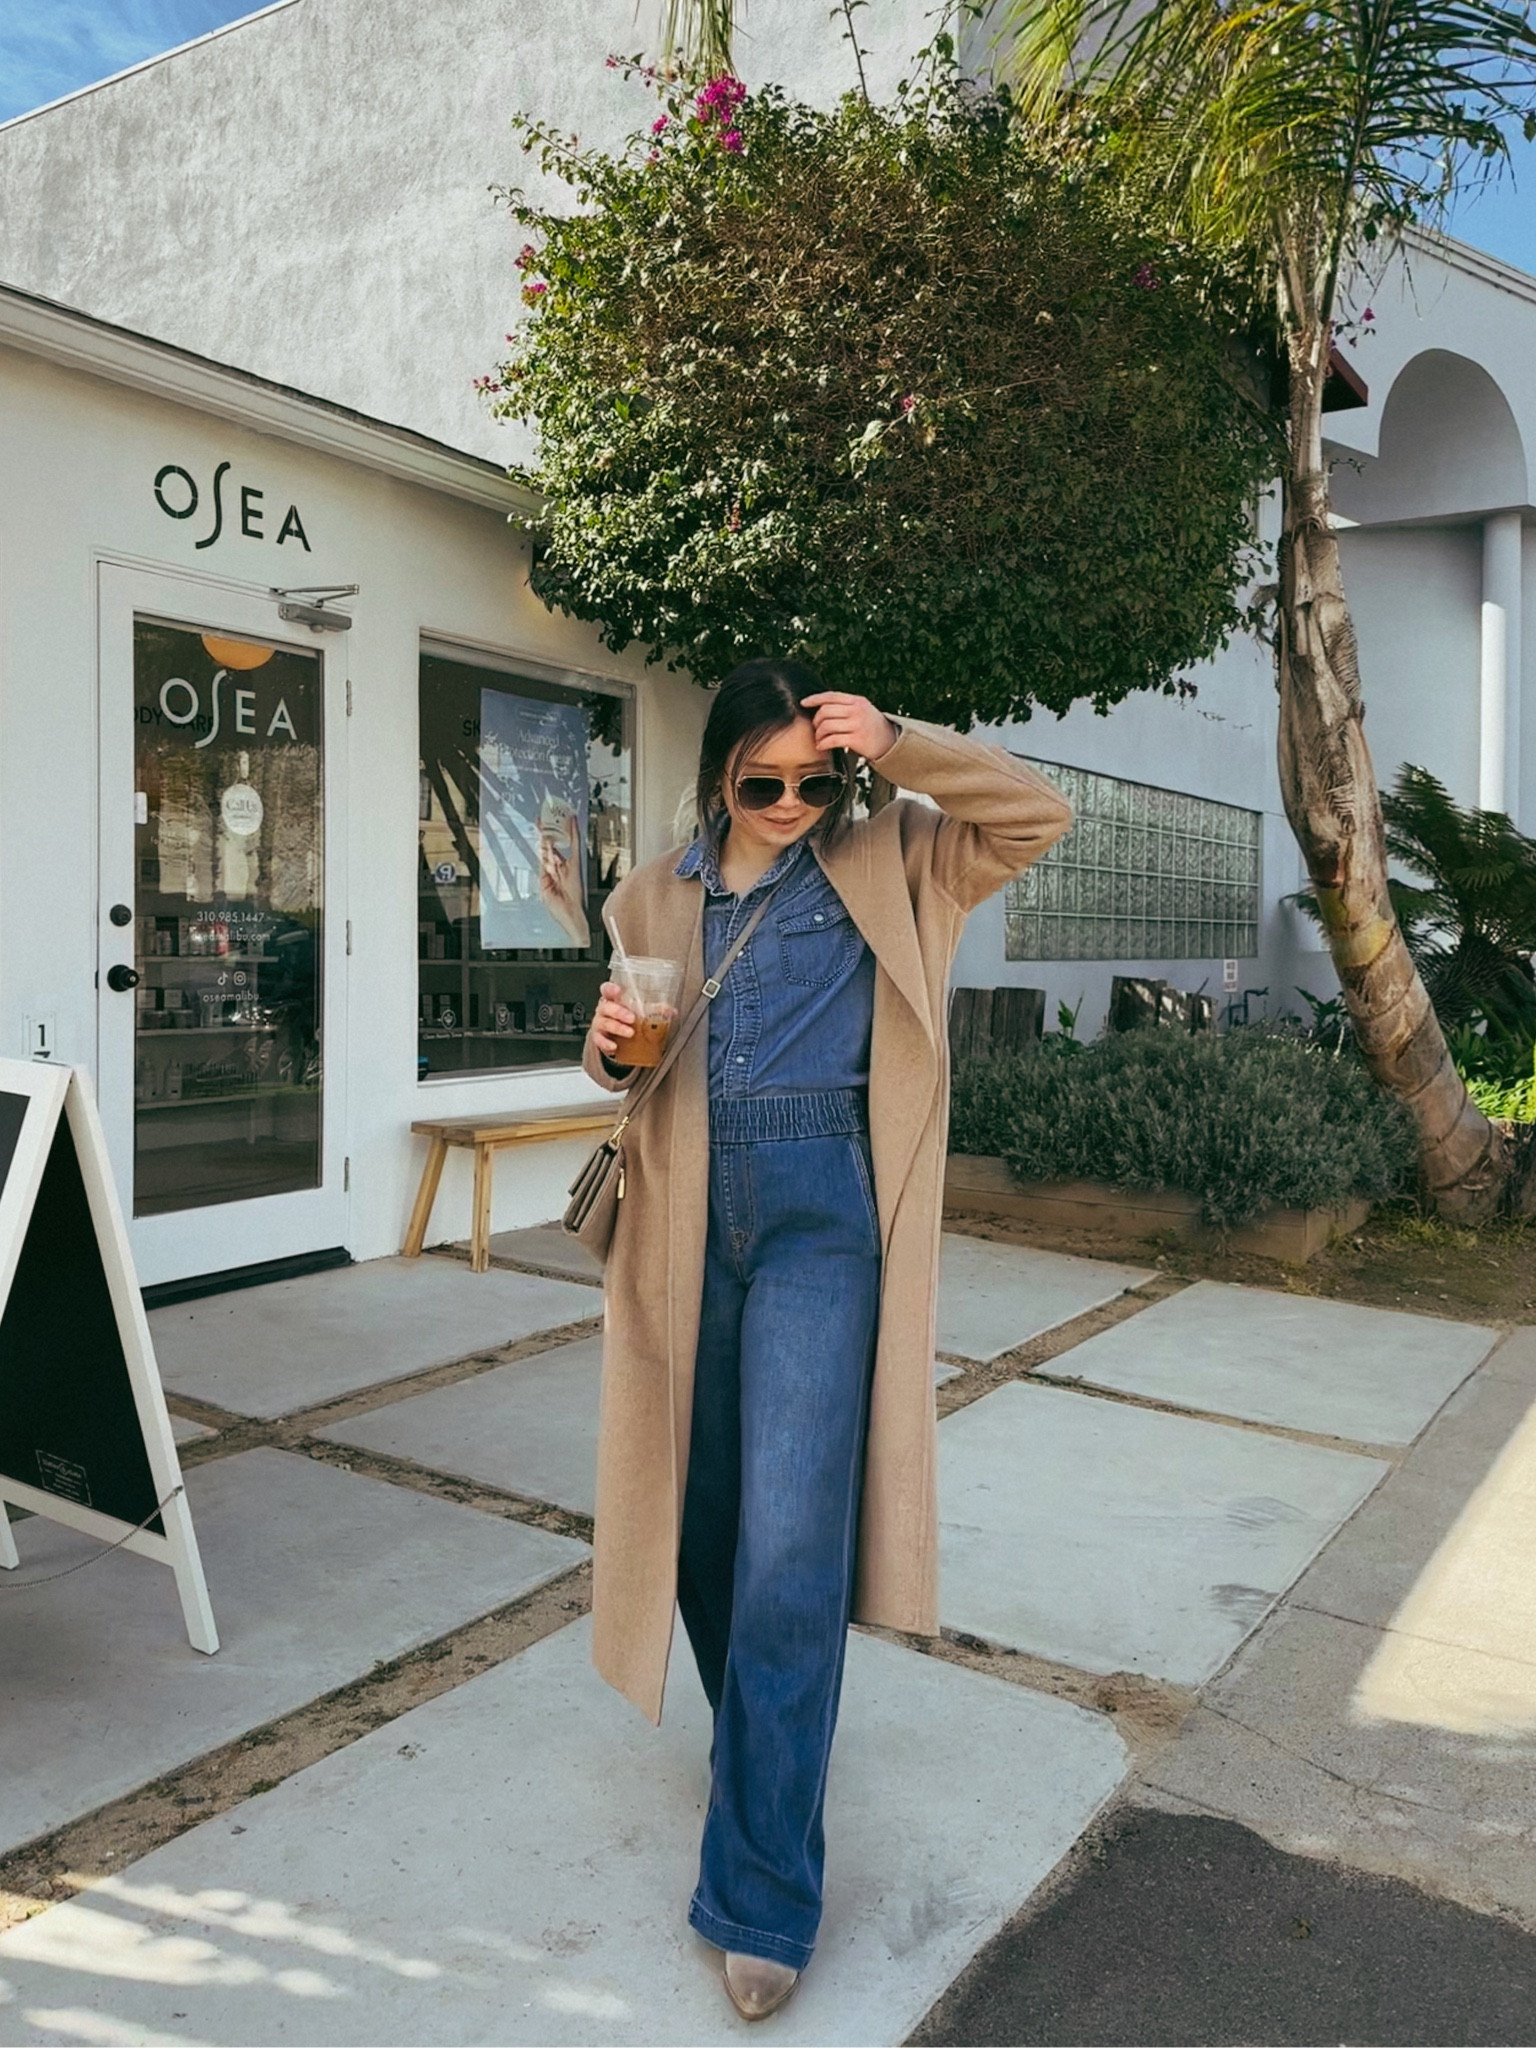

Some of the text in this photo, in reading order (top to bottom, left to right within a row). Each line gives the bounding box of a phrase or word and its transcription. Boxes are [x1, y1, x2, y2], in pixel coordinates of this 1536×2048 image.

[154, 461, 311, 552] OSEA
[159, 669, 297, 749] OSEA
[196, 911, 265, 923] 310.985.1447
[191, 929, 271, 942] eamalibu.com
[202, 989, 260, 1003] oseamalibu
